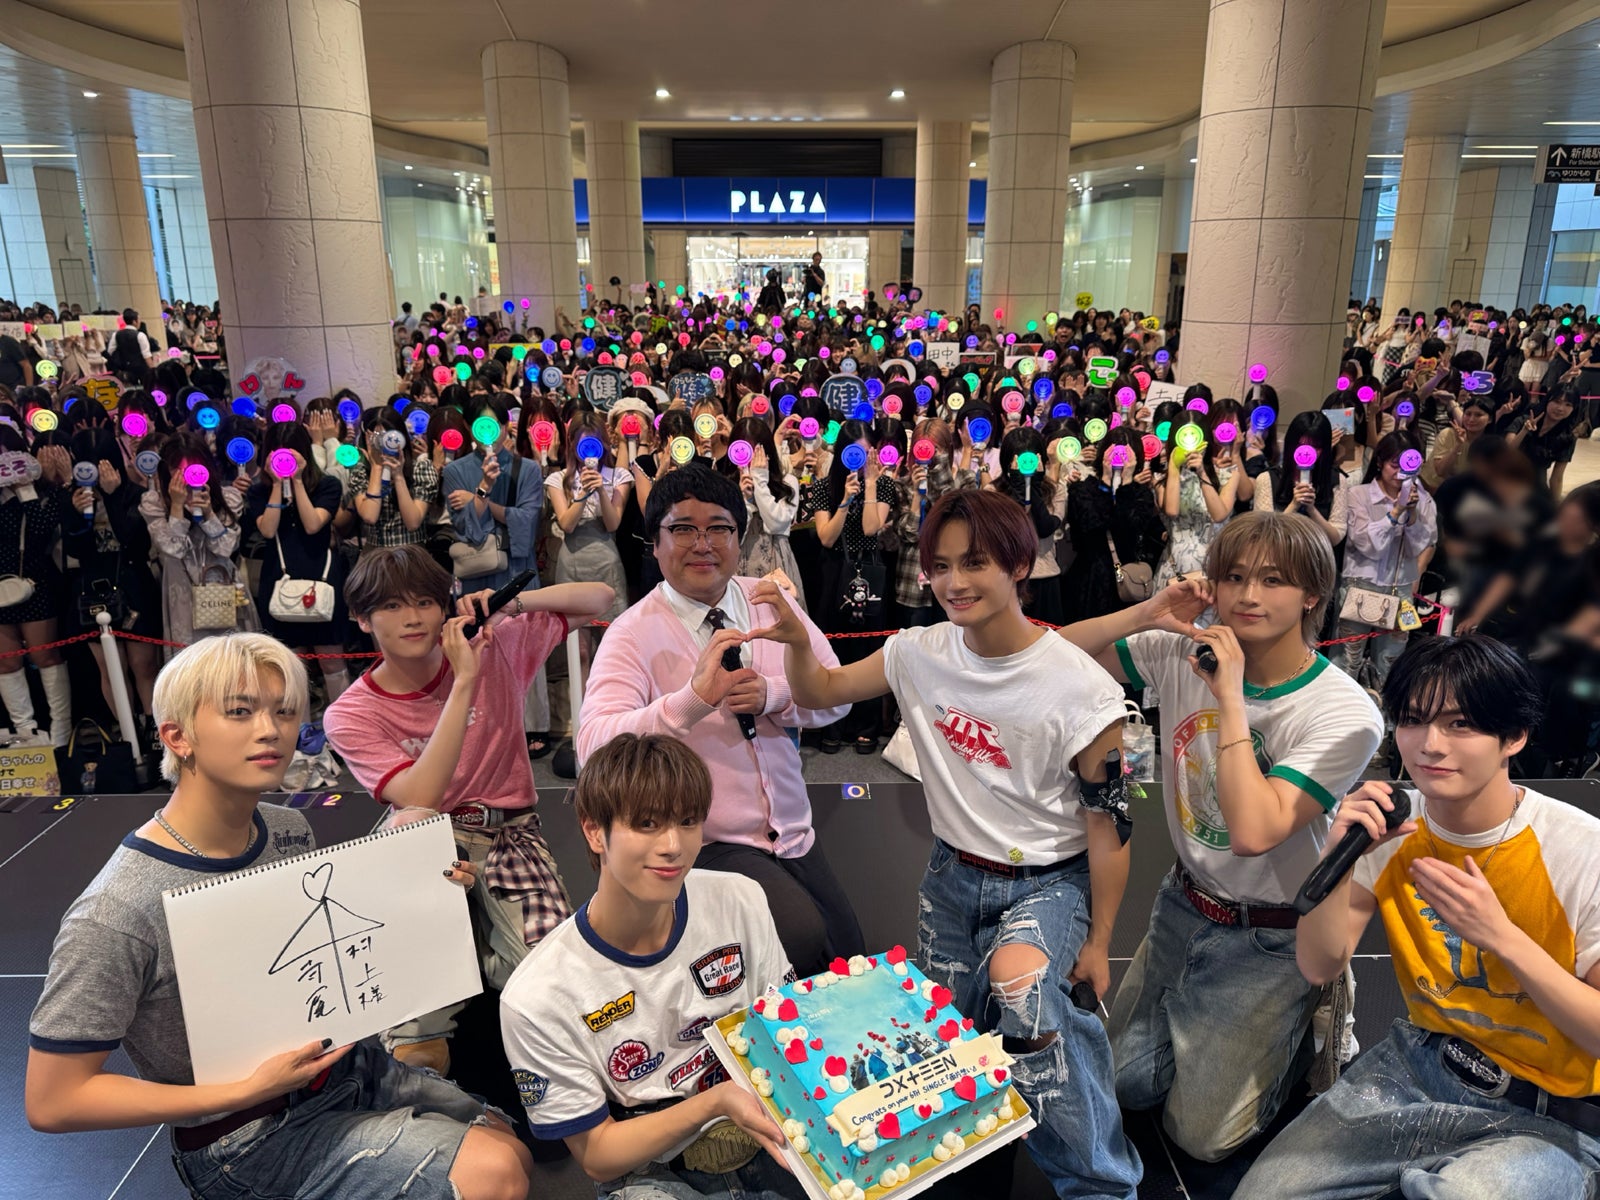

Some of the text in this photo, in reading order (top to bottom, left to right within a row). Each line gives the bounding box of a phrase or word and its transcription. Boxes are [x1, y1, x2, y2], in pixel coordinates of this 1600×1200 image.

[731, 190, 826, 213] PLAZA
[928, 346, 953, 360] 田中
[201, 600, 233, 608] CELINE
[946, 734, 994, 763] London UK
[1174, 729, 1190, 749] OF
[322, 794, 342, 806] 2
[847, 785, 865, 798] 0
[53, 798, 75, 810] 3
[695, 952, 720, 970] GRAND
[704, 961, 740, 982] Great Race
[590, 1000, 632, 1027] RENDER
[851, 1106, 887, 1126] Congrats
[896, 1096, 908, 1107] your
[922, 1077, 947, 1094] SINGLE
